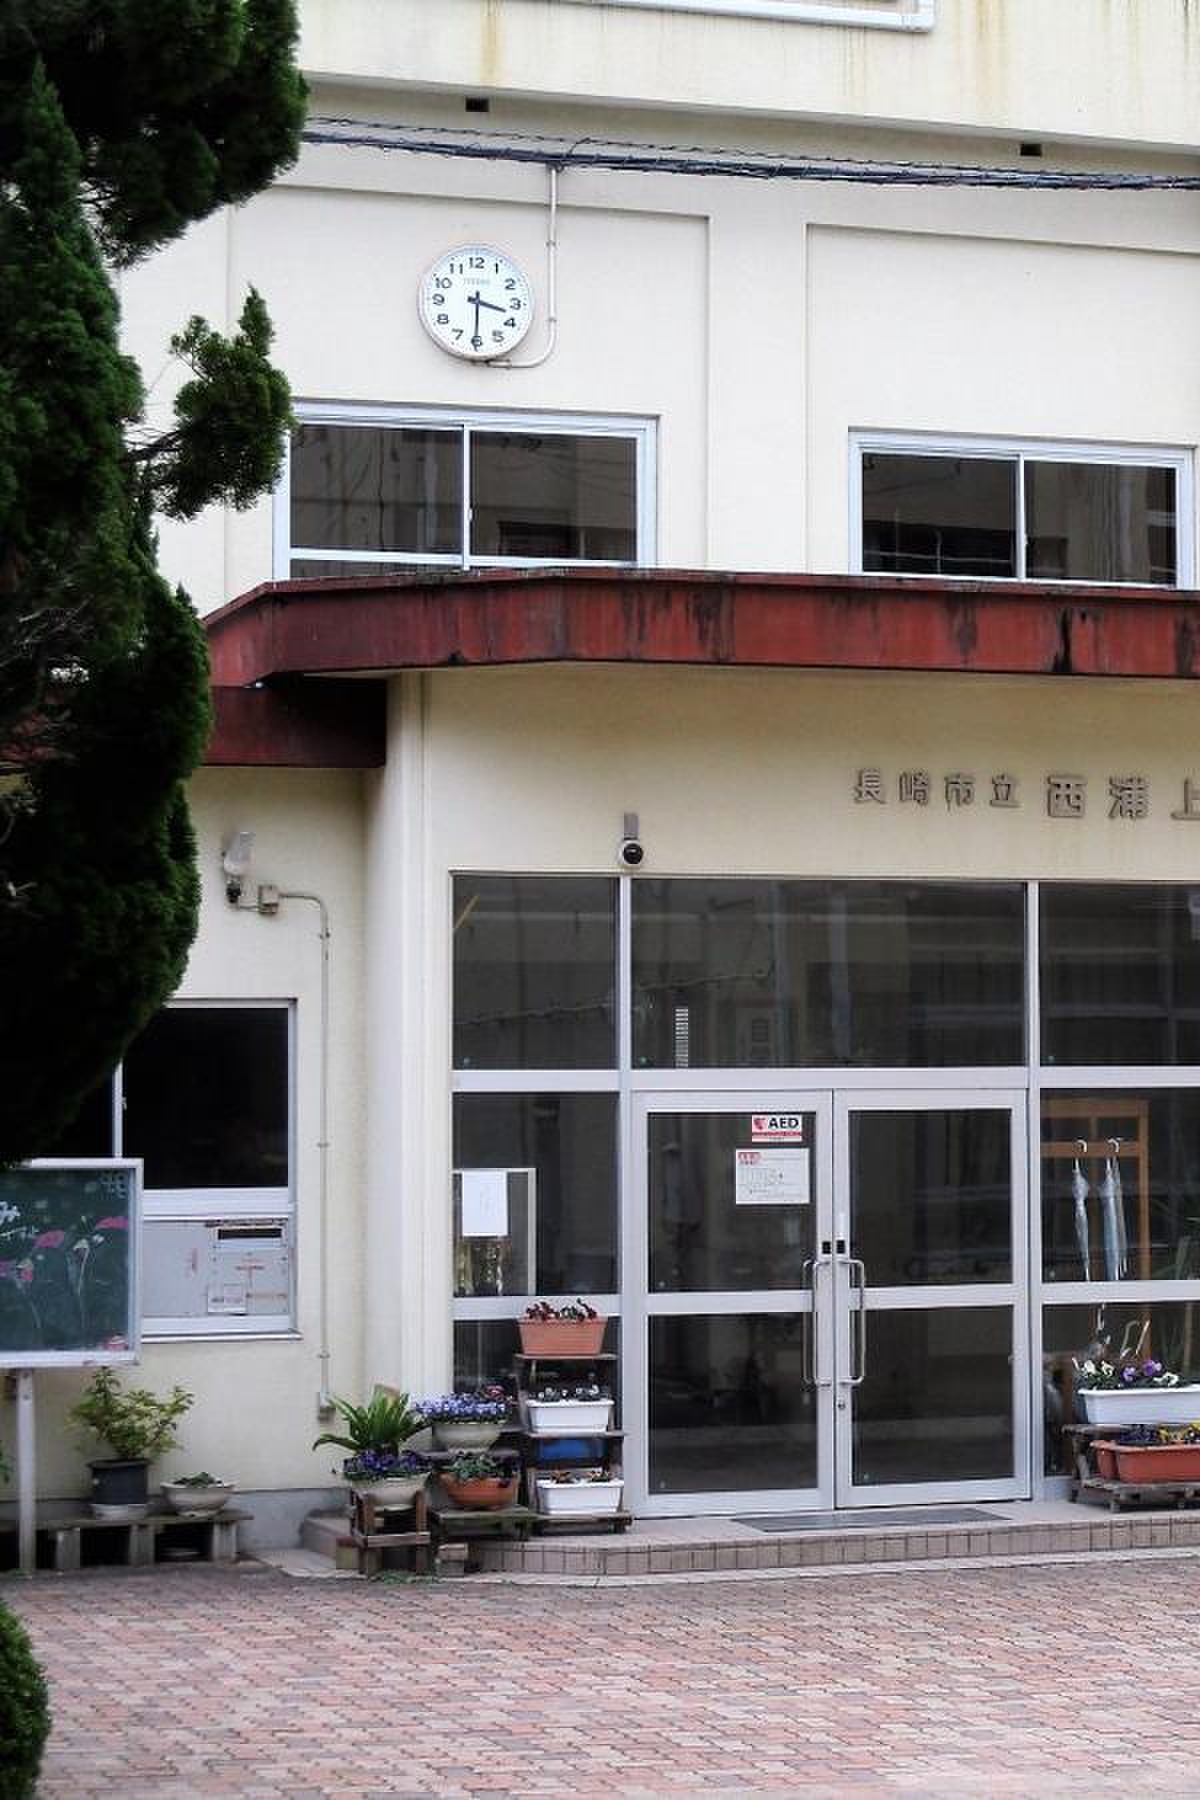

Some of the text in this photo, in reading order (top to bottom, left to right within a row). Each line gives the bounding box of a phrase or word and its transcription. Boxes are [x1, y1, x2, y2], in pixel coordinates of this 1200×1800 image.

[449, 262, 464, 275] 11
[468, 256, 485, 269] 12
[493, 262, 499, 275] 1
[435, 277, 453, 289] 10
[505, 278, 517, 291] 2
[432, 293, 445, 306] 9
[509, 297, 522, 310] 3
[436, 313, 449, 325] 8
[503, 317, 516, 328] 4
[451, 328, 464, 341] 7
[492, 330, 504, 343] 5
[470, 335, 484, 348] 6
[767, 1117, 800, 1130] AED
